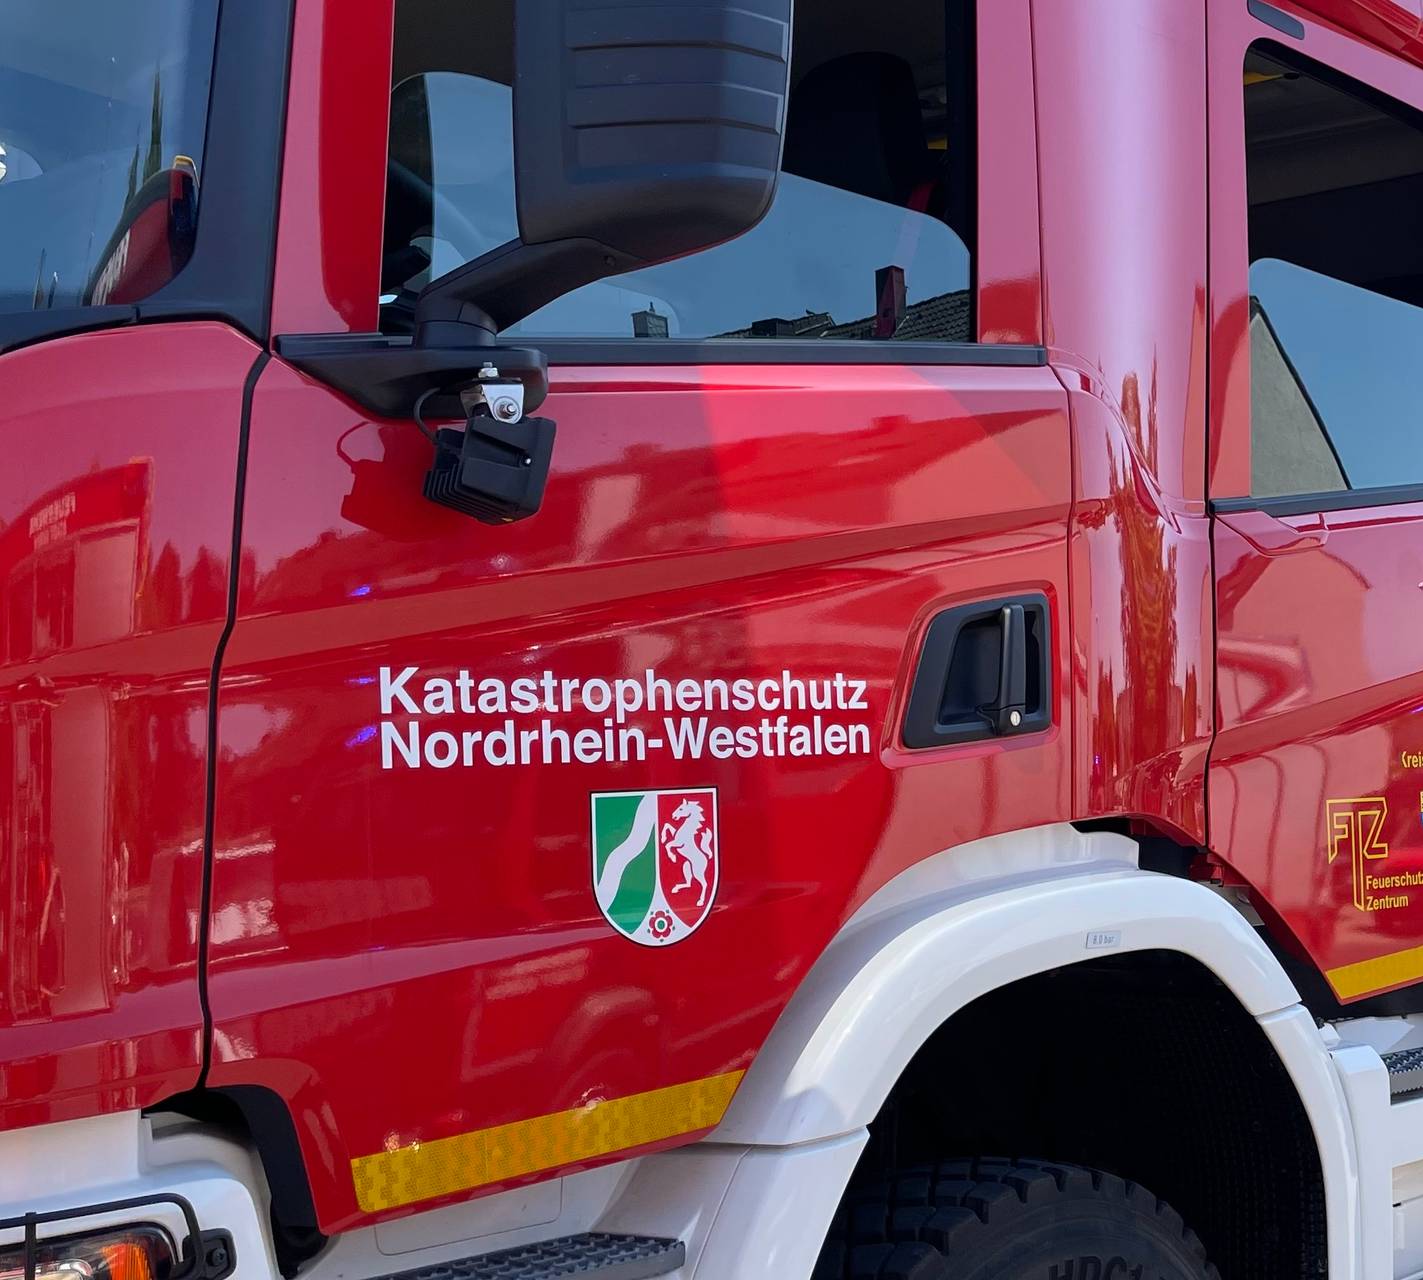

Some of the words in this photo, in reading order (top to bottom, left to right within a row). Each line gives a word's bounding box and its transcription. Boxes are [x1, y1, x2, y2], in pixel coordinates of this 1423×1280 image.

[379, 666, 869, 723] Katastrophenschutz
[380, 715, 871, 769] Nordrhein-Westfalen
[1366, 895, 1409, 911] Zentrum
